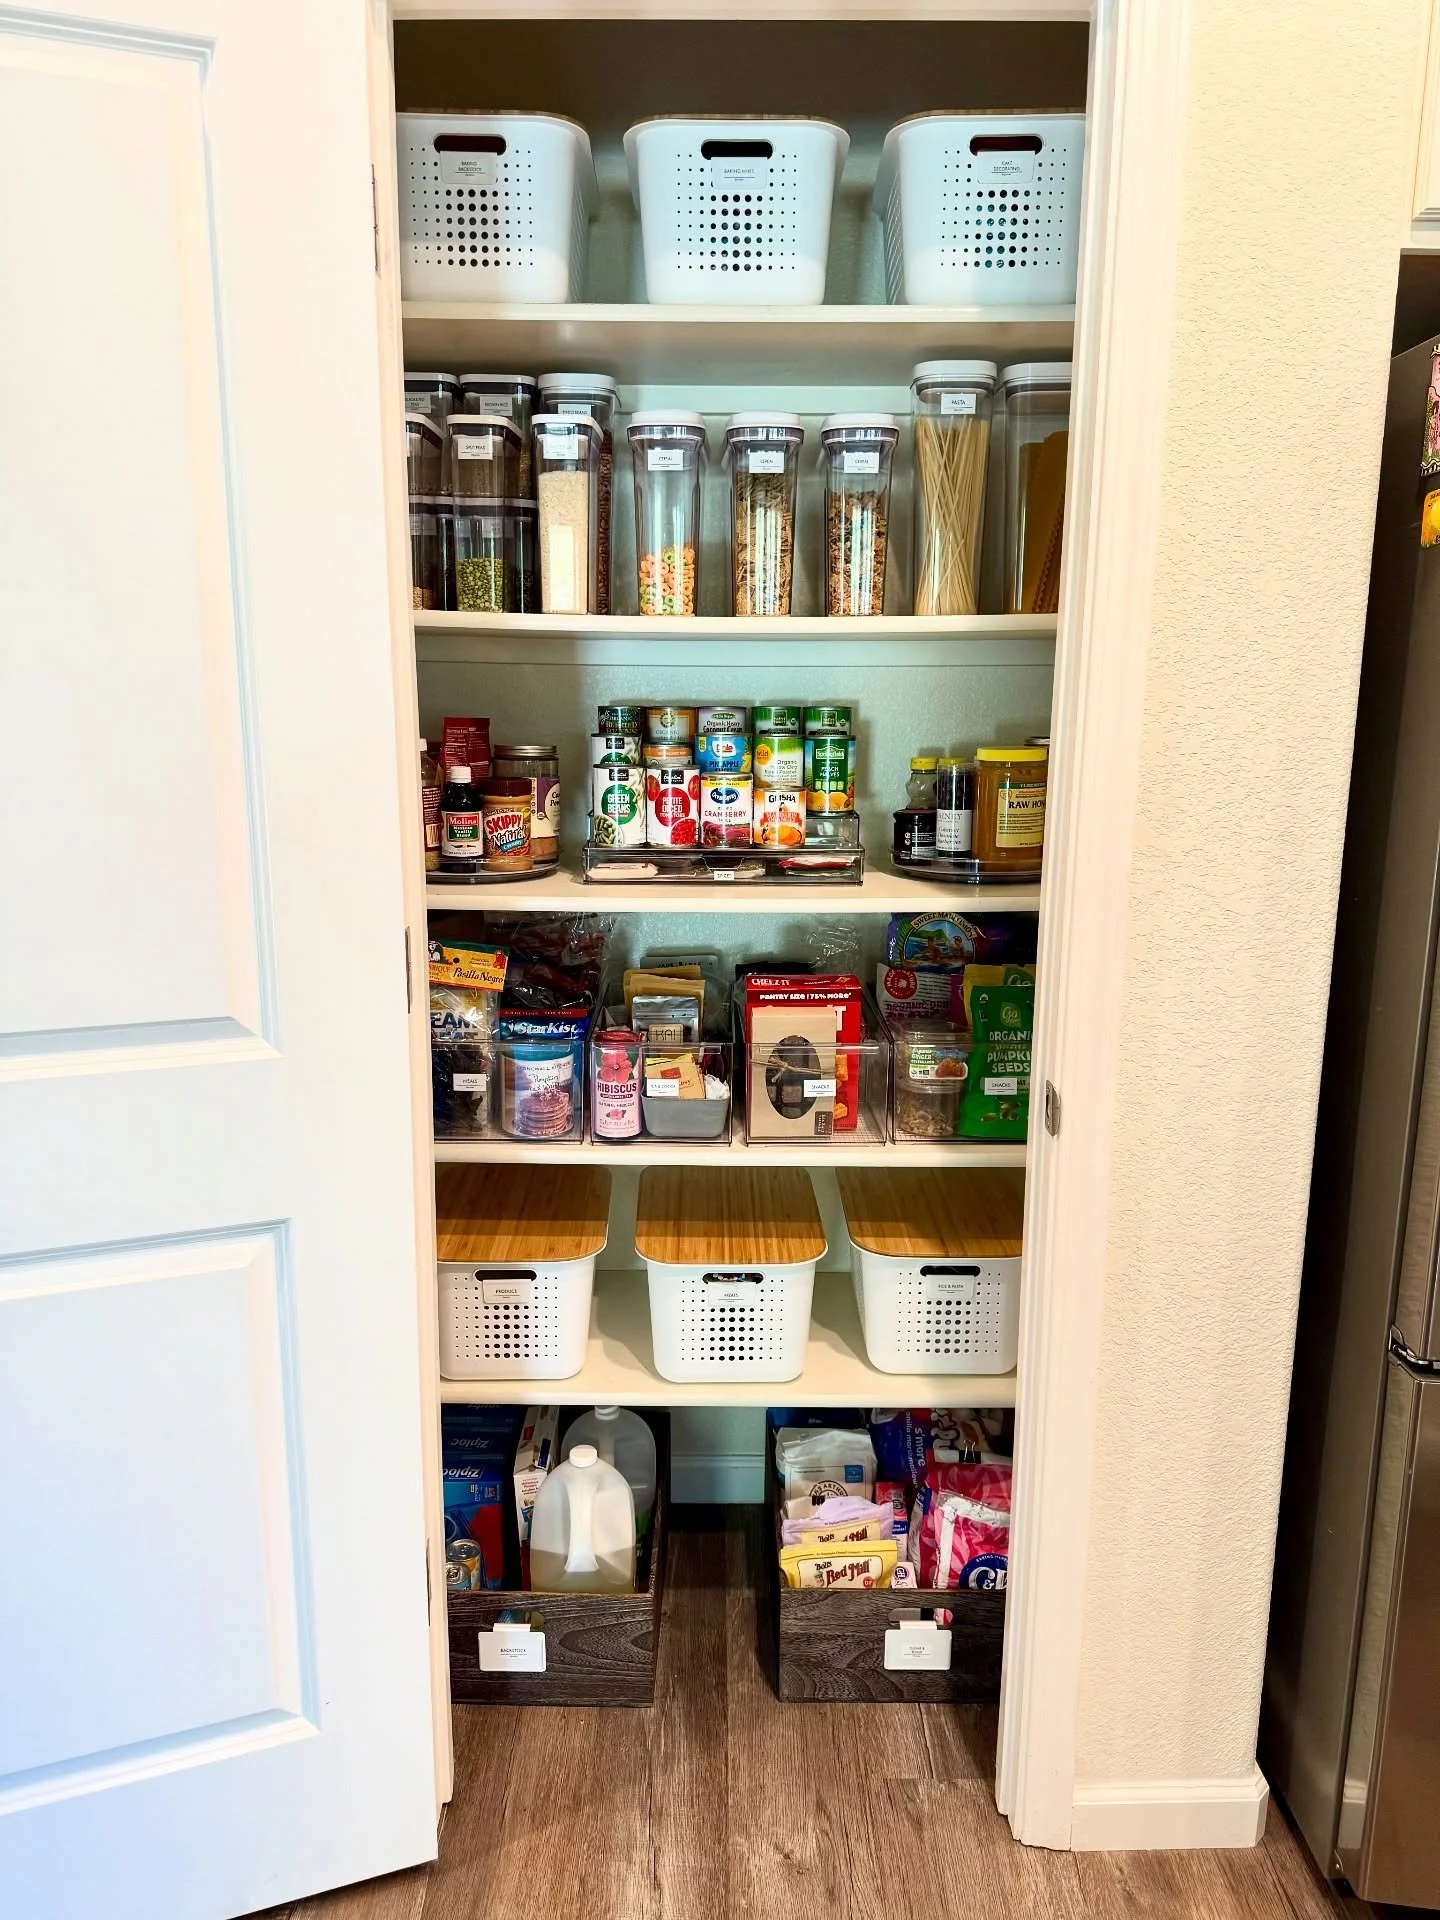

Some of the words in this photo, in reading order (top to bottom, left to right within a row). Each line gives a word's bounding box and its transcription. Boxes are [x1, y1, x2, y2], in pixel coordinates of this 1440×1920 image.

[607, 793, 630, 803] GREEN
[607, 804, 631, 813] BEANS
[1008, 801, 1030, 809] RAW
[1032, 800, 1045, 808] HON
[449, 816, 477, 825] Molina
[486, 814, 522, 835] SKIPPY
[492, 825, 527, 848] Natural
[913, 912, 937, 928] SWEET
[453, 967, 479, 980] Pasilla
[480, 971, 504, 984] Negro
[518, 1021, 579, 1034] StarKist
[655, 1029, 676, 1041] KAI
[987, 1050, 1032, 1062] PUMPKI
[991, 1062, 1031, 1073] SEEDS
[597, 1082, 637, 1094] HIBISCUS
[451, 1438, 489, 1449] Ziploc
[823, 1484, 845, 1497] ARTHU
[817, 1534, 835, 1543] Bob's
[814, 1560, 832, 1571] Bob's
[826, 1565, 847, 1588] Red
[848, 1559, 870, 1582] Mill
